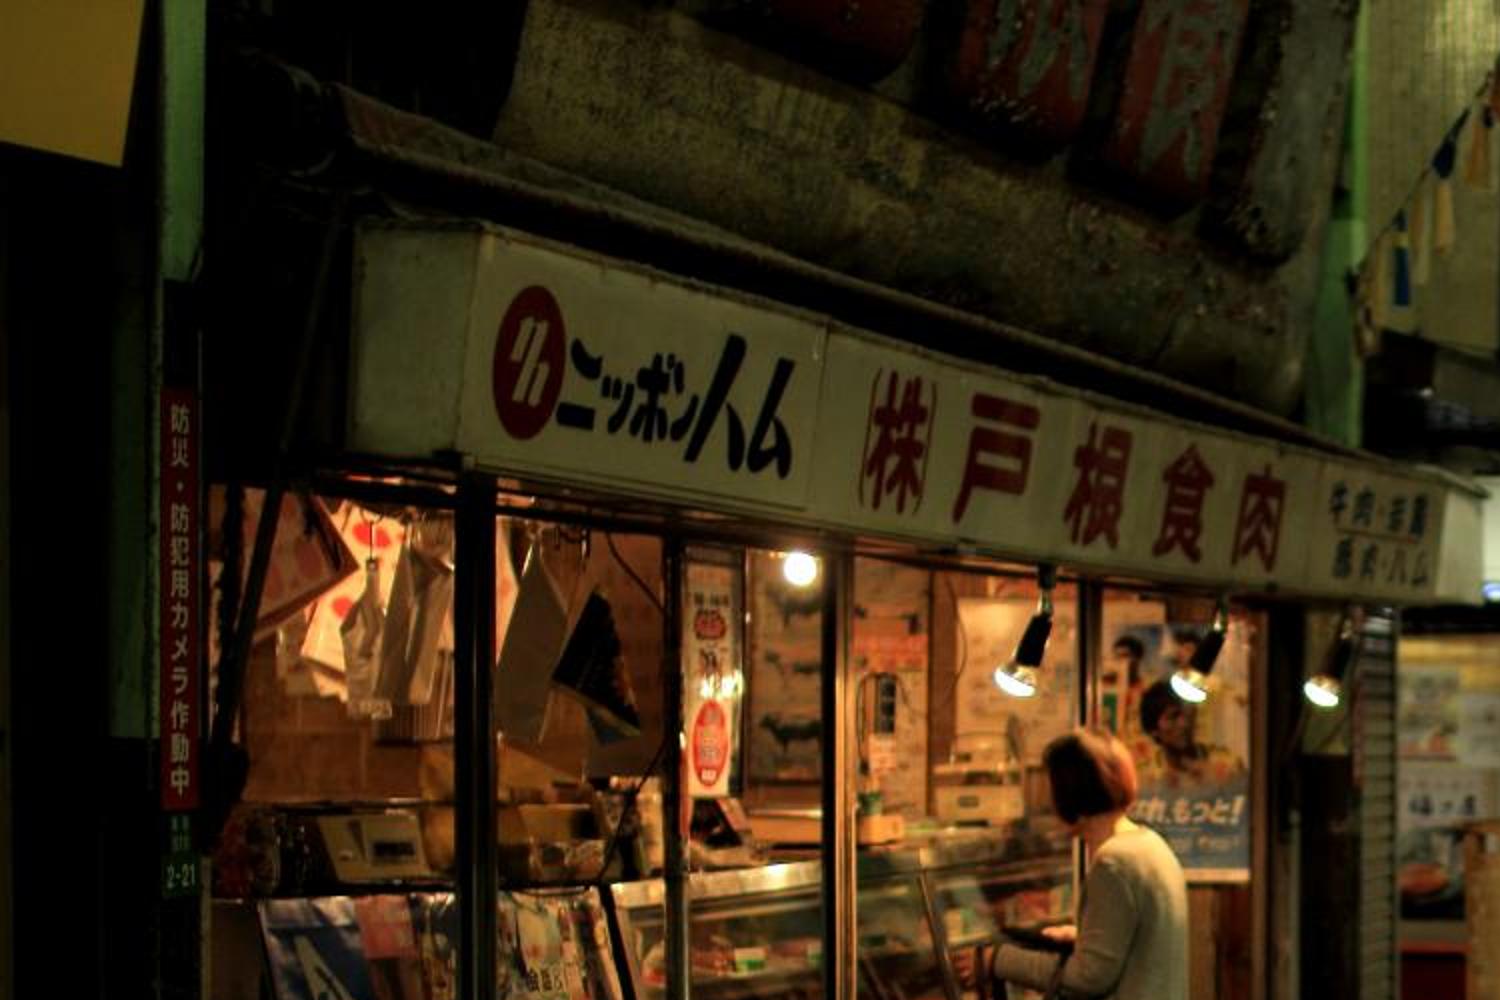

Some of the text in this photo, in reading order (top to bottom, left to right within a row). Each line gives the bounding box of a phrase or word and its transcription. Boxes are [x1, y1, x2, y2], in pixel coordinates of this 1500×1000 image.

[555, 332, 796, 480] ニッポンハム
[169, 402, 192, 797] 防災・防犯用カメラ作動中
